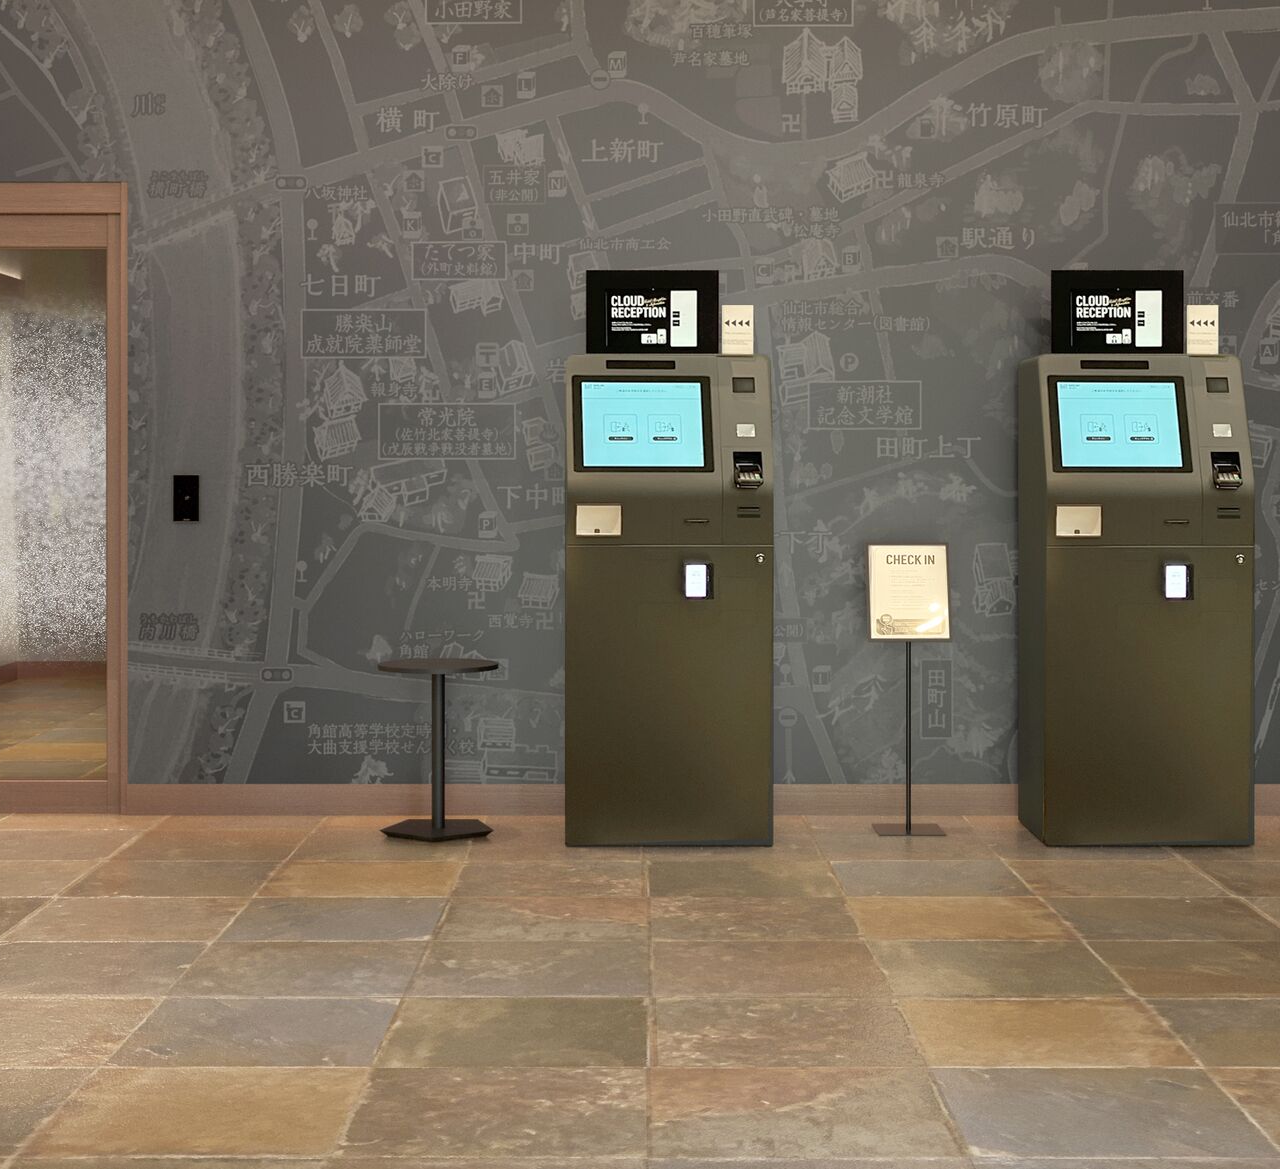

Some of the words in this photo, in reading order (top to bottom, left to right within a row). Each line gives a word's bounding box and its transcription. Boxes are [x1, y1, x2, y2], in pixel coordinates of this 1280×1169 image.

[435, 0, 513, 19] 小田野家
[376, 107, 440, 134] 横町
[966, 103, 1049, 129] 竹原町
[581, 138, 664, 164] 上新町
[488, 170, 541, 186] 五井家
[305, 185, 369, 201] 八坂神社
[579, 237, 672, 252] 仙北市商工会
[960, 226, 1036, 251] 駅通り
[513, 243, 562, 265] 中町
[301, 274, 382, 297] 七日町
[611, 295, 645, 307] CLOUD
[783, 300, 862, 316] 仙北市総合
[1076, 295, 1110, 307] CLOUD
[611, 307, 666, 318] RECEPTION
[1076, 307, 1131, 318] RECEPTION
[335, 314, 393, 333] 勝楽山
[306, 336, 422, 354] 成就院薬師堂
[370, 382, 418, 398] 報身寺
[836, 384, 894, 405] 新潮社
[417, 407, 477, 427] 常光院
[816, 405, 914, 426] 記念文学館
[875, 435, 982, 460] 田町上丁
[244, 463, 354, 488] 西勝楽町
[886, 554, 922, 565] CHECK
[924, 554, 936, 565] IN
[399, 643, 430, 659] 角館
[927, 669, 947, 729] 田町山
[307, 722, 457, 739] 角館高等学校定時・
[307, 739, 476, 756] 大曲支援学校せんく校
